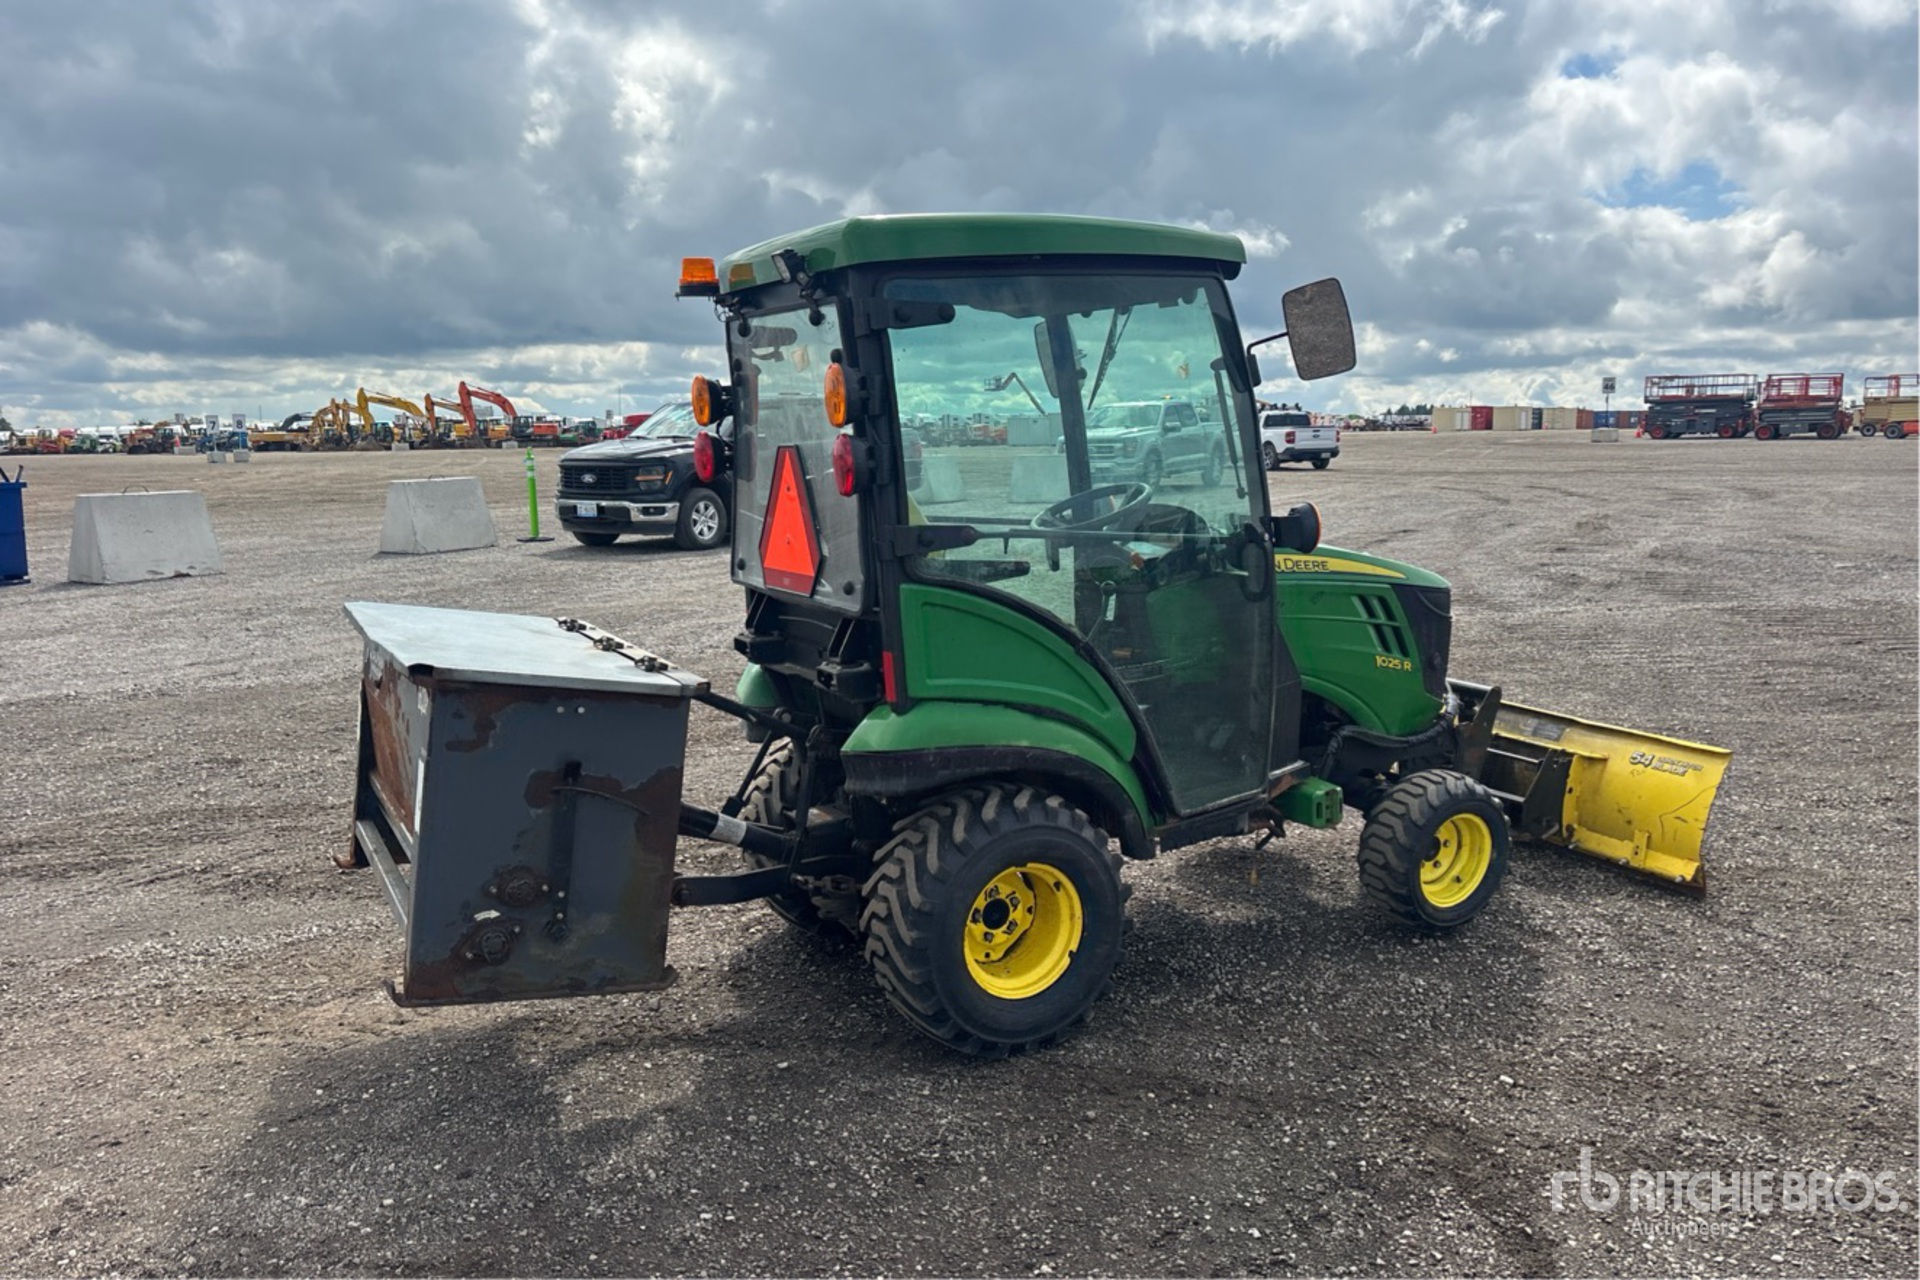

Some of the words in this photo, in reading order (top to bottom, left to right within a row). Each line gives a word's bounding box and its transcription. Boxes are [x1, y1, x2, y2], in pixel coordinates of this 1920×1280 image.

[1603, 382, 1615, 391] 46
[208, 420, 216, 431] 7
[236, 419, 243, 429] 8
[1283, 557, 1330, 571] DEERE
[1374, 655, 1402, 670] 1025
[1403, 660, 1412, 672] R
[1629, 751, 1655, 768] 54
